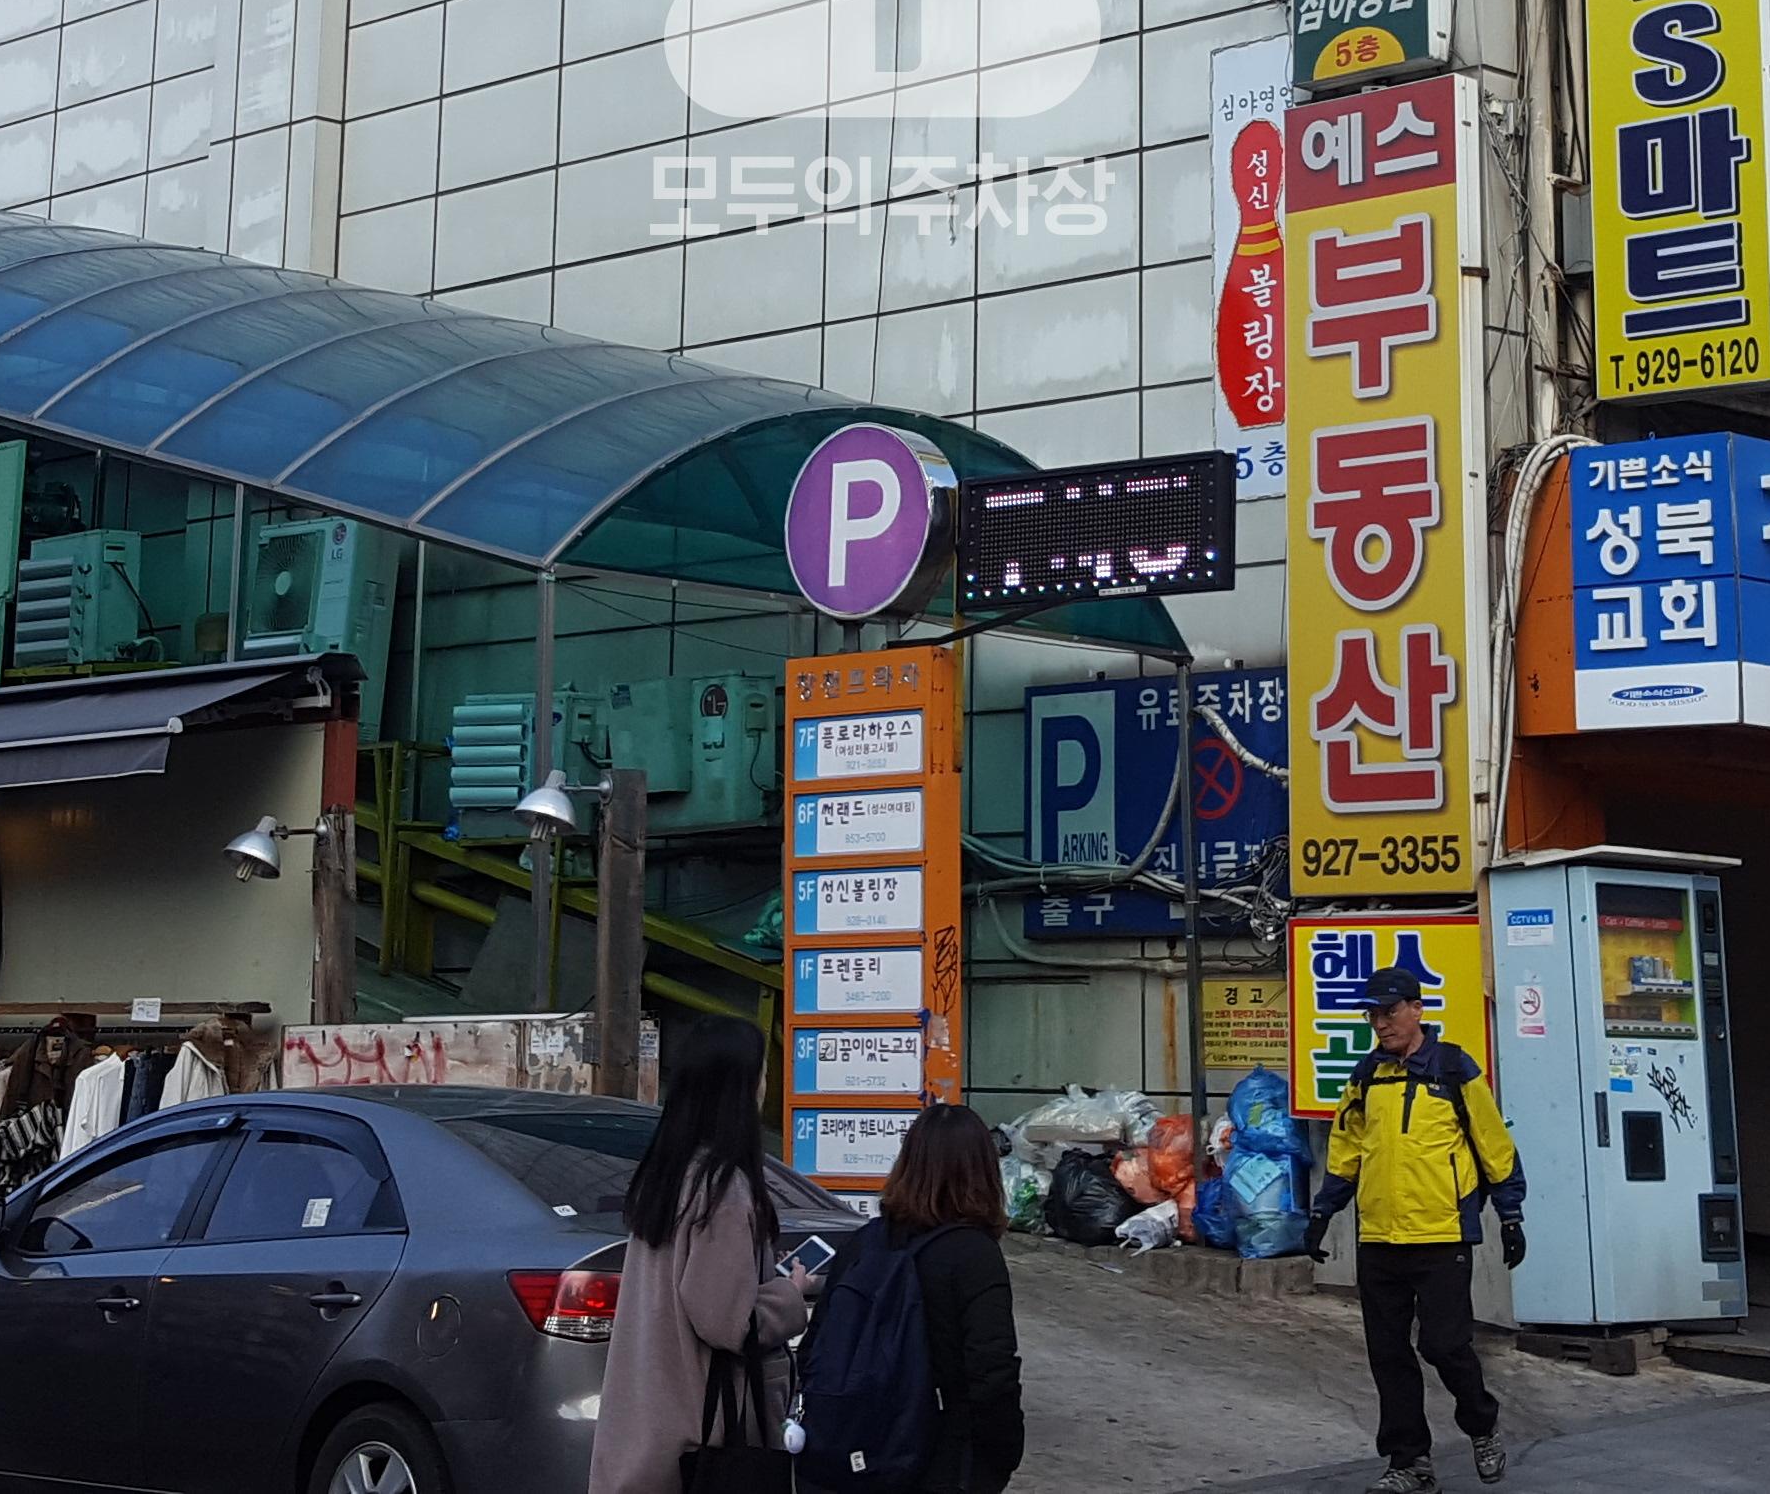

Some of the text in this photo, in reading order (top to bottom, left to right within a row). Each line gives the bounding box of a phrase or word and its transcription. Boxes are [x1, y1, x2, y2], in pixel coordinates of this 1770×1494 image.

[1333, 34, 1381, 68] 5층
[1301, 99, 1440, 187] 예스
[1246, 148, 1270, 211] 성신
[1241, 263, 1282, 413] 볼링장
[1236, 441, 1286, 480] 5층
[1588, 450, 1713, 491] 기쁜소식
[828, 459, 901, 587] P
[1308, 212, 1457, 814] 부동산
[1586, 499, 1715, 575] 성북
[1589, 578, 1718, 651] 교회
[799, 727, 816, 748] 7F
[821, 720, 913, 749] 플로라하우스
[798, 802, 815, 823] 6F
[1301, 834, 1462, 877] 927-3355
[799, 880, 816, 901] 5F
[821, 878, 898, 903] 성신볼링장
[1040, 893, 1114, 926] 출구
[821, 957, 881, 982] 프렌들리
[1225, 987, 1263, 1005] 경고
[798, 1037, 815, 1058] 3F
[839, 1037, 918, 1062] 꿈이있는교회
[797, 1118, 815, 1139] 2F
